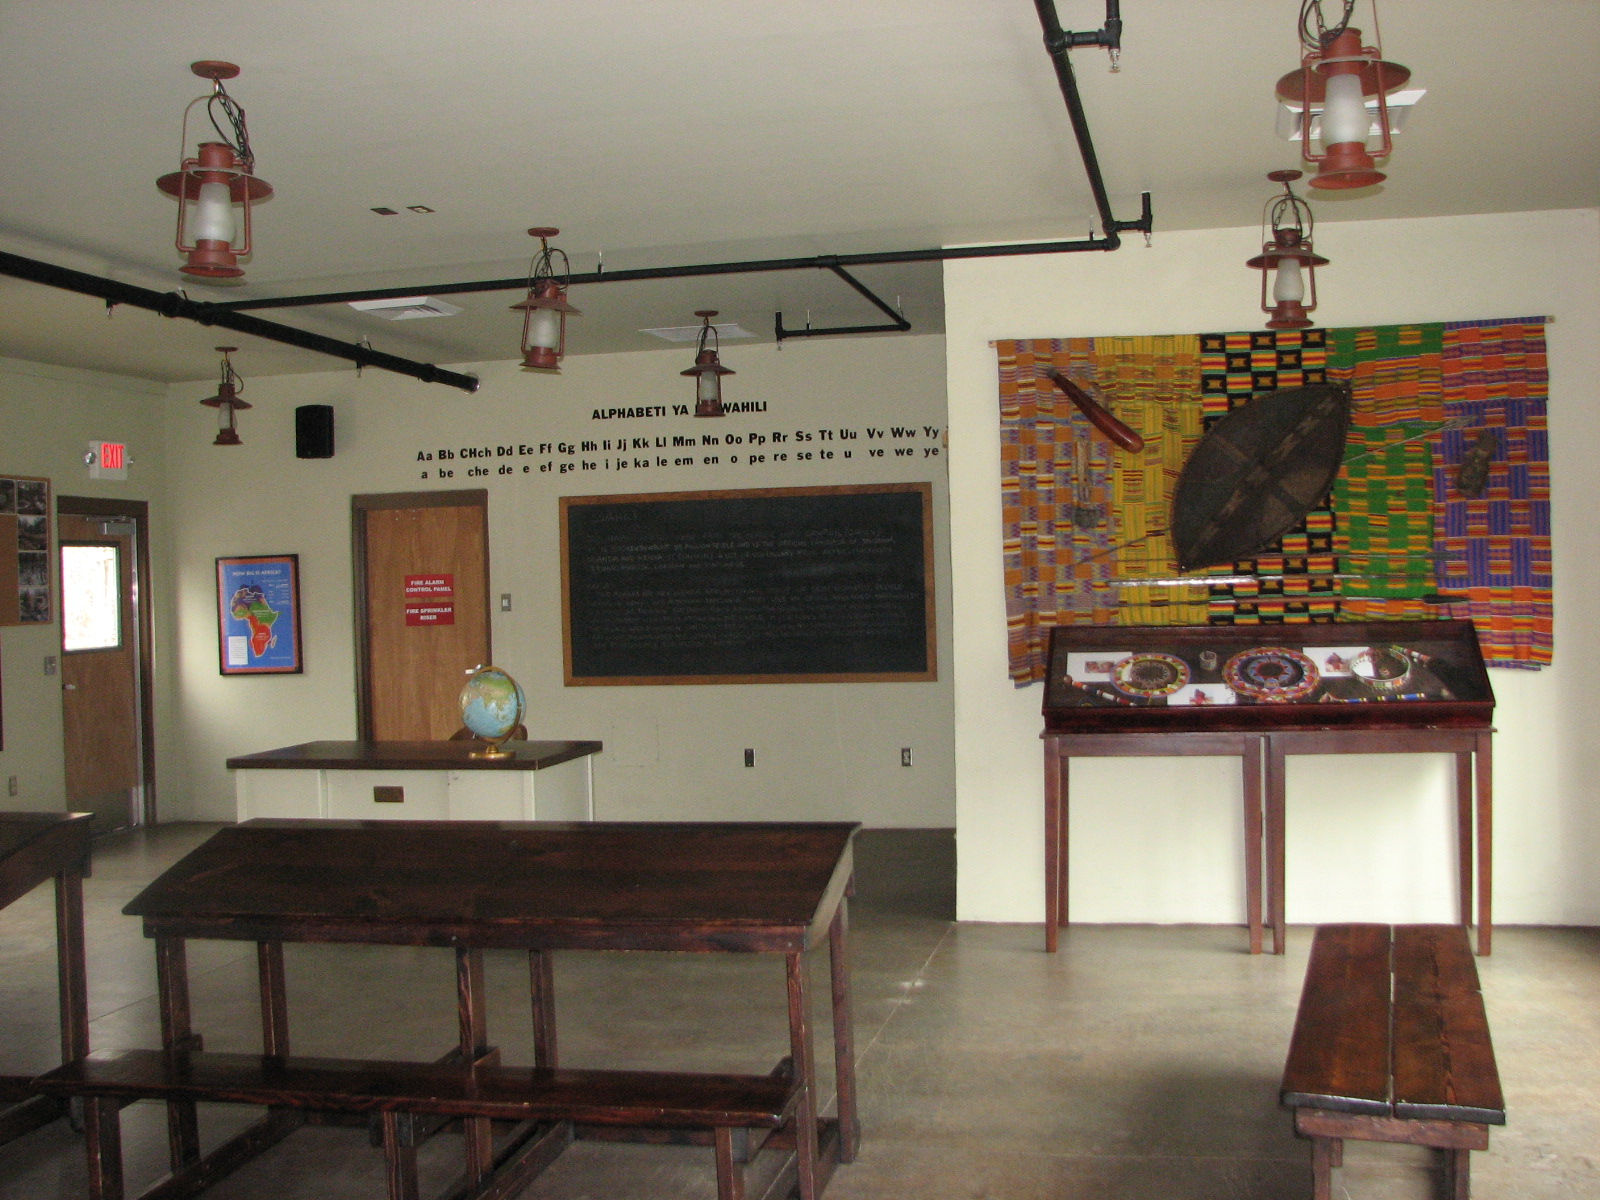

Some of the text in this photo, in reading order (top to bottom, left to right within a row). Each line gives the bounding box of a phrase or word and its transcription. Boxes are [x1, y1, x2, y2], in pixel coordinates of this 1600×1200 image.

[591, 401, 767, 421] ALPHABETI YA WAHILI
[101, 443, 125, 470] EXIT
[416, 450, 433, 462] Aa
[438, 449, 455, 461] Bb
[459, 446, 492, 459] CHch
[496, 445, 514, 457] Dd
[518, 444, 534, 456] Ee
[539, 442, 552, 455] Ff
[557, 442, 576, 456] Gg
[581, 440, 598, 452] Hh
[616, 438, 627, 452] Jj
[632, 437, 650, 449] Kk
[655, 436, 667, 448] Ll
[672, 435, 696, 447] Mm
[701, 434, 719, 446] Nn
[724, 433, 743, 445] Oo
[748, 432, 766, 446] Pp
[772, 431, 789, 443] Rr
[794, 430, 813, 442] Ss
[818, 429, 834, 441] Tt
[839, 428, 857, 441] Uu
[866, 427, 885, 440] Vv
[890, 426, 917, 439] Ww
[922, 425, 940, 440] Yy
[420, 447, 940, 480] a be che de e ef ge he i je ka le em en o pe re se te u ve we ye
